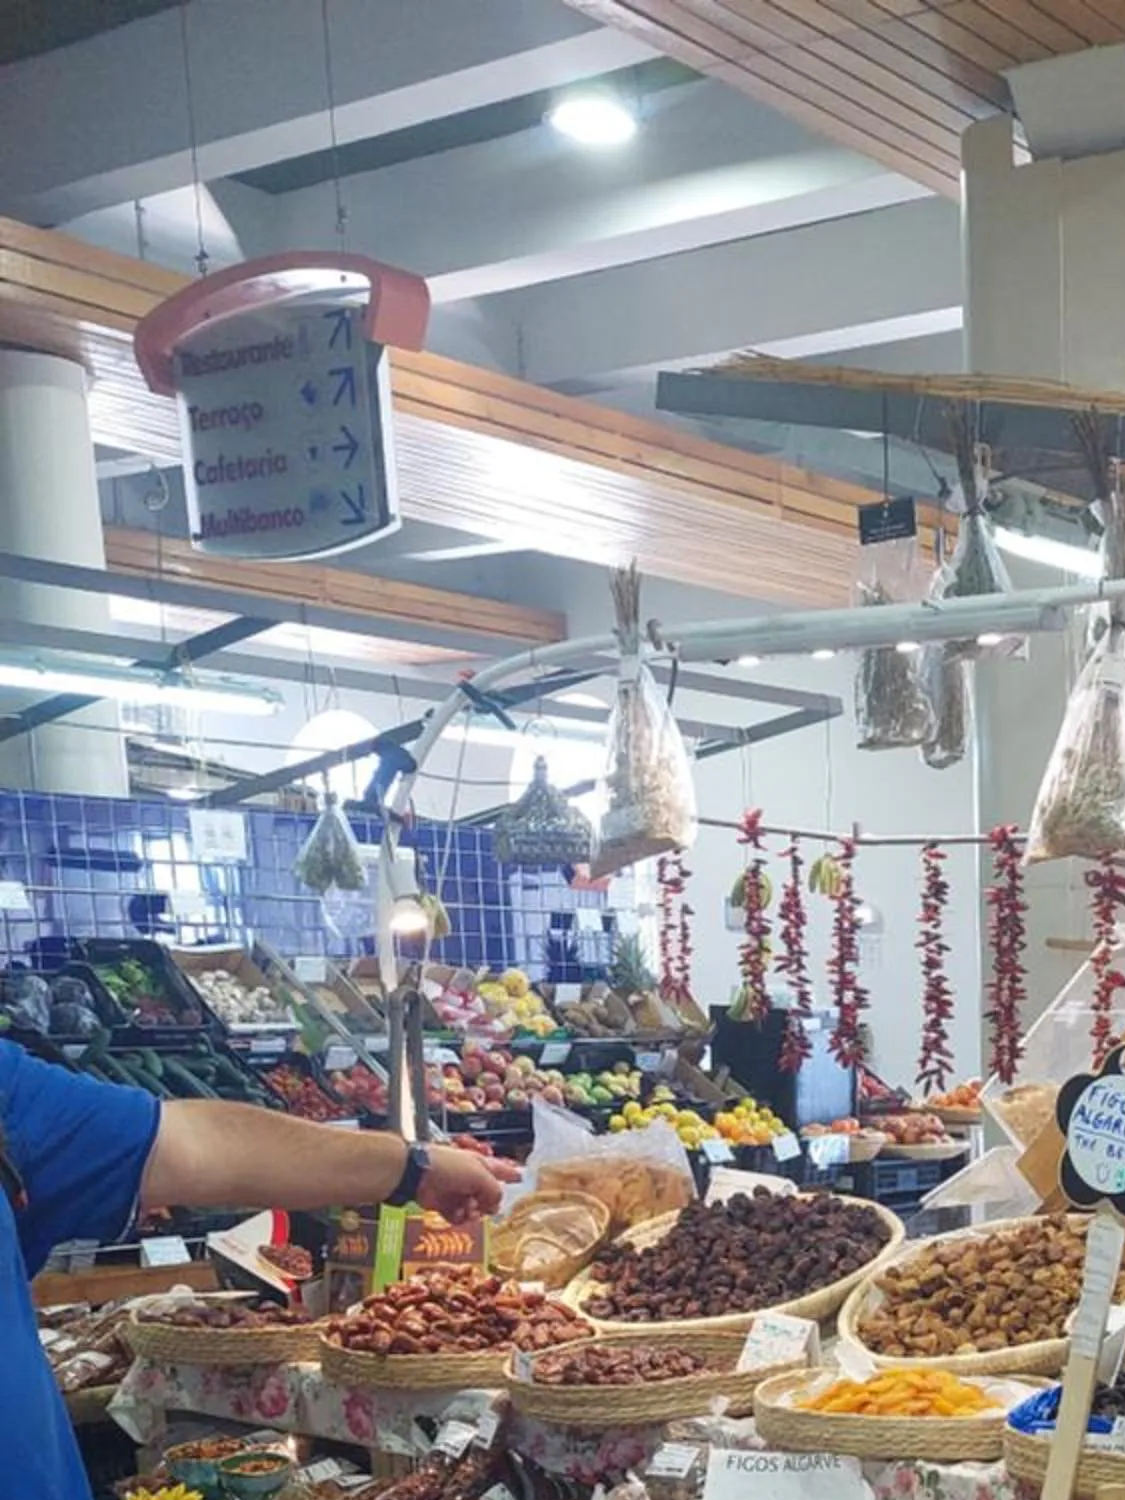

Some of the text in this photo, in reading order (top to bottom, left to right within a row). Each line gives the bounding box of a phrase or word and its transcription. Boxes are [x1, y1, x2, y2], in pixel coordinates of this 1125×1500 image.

[187, 401, 263, 432] Terraço
[200, 508, 304, 540] Multibanco
[1074, 1133, 1098, 1151] THE
[726, 1454, 842, 1473] FIGOS ALGARVE
